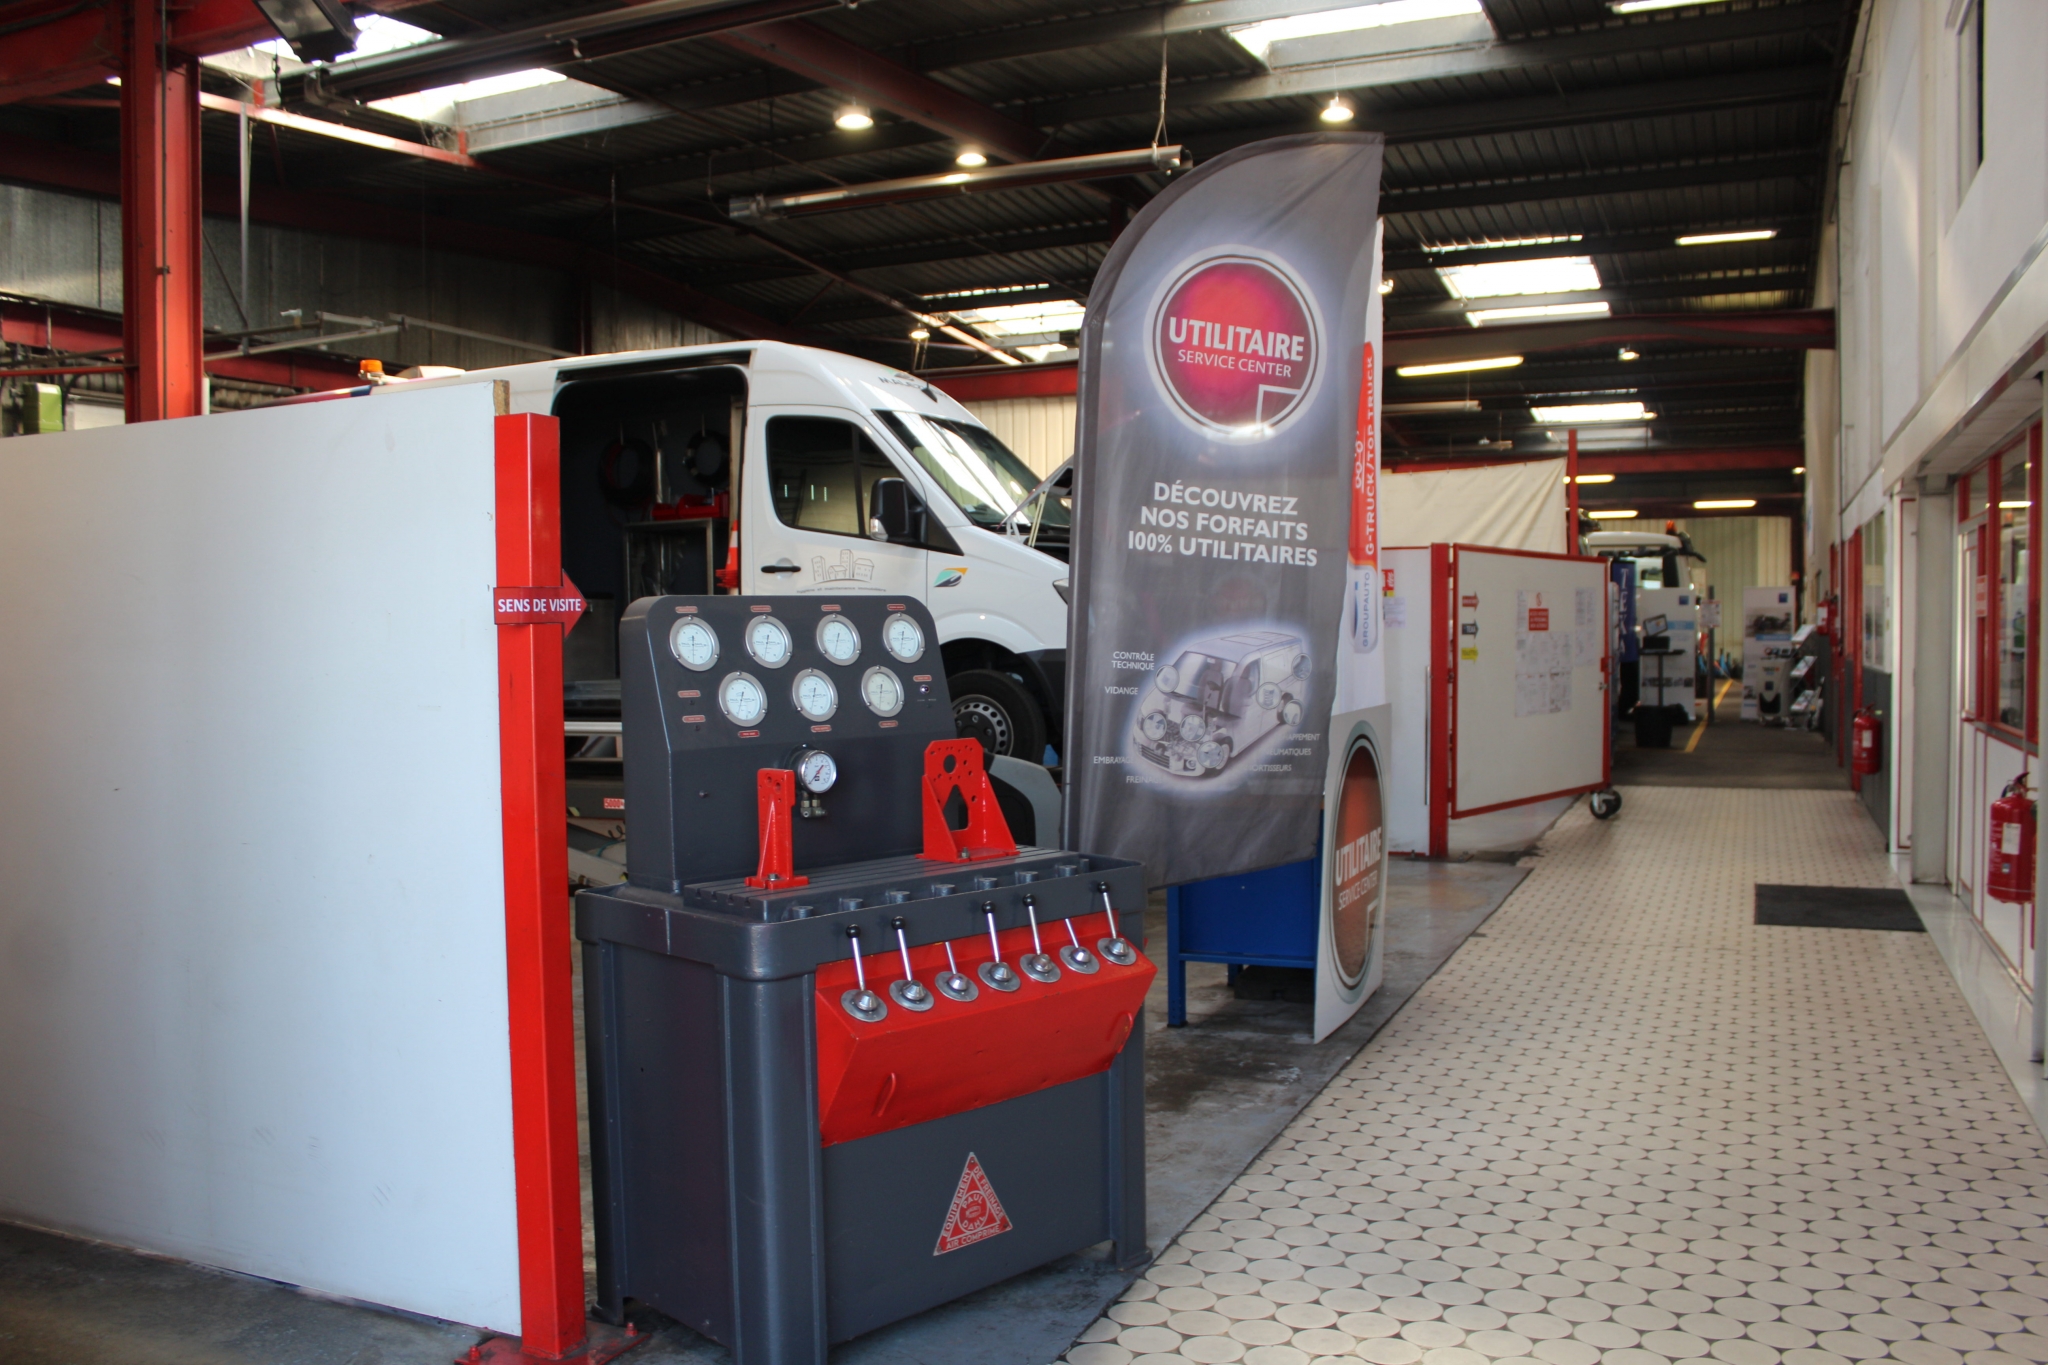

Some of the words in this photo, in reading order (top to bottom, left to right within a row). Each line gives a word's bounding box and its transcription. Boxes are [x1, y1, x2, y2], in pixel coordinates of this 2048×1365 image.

[1169, 316, 1305, 362] UTILITAIRE
[1177, 349, 1236, 370] SERVICE
[1238, 358, 1292, 378] CENTER
[1154, 479, 1299, 516] DÉCOUVREZ
[1365, 424, 1375, 555] G-TRUCK/TOP
[1140, 505, 1189, 530] NOS
[1196, 512, 1308, 541] FORFAITS
[1128, 530, 1173, 553] 100%
[1179, 536, 1318, 567] UTILITAIRES
[498, 598, 531, 613] SENS
[533, 598, 547, 612] DE
[549, 598, 582, 612] VISITE
[1362, 571, 1371, 647] GROUPAUTO
[1111, 660, 1155, 671] TECHNIQUE
[1113, 650, 1155, 662] CONTRÔLE
[1104, 686, 1139, 696] VIDANGE
[1335, 826, 1382, 887] UTILITAIRE
[1338, 880, 1361, 911] SERVICE
[942, 1166, 972, 1238] EQUIPEMENT
[961, 1193, 984, 1209] PAUL
[973, 1165, 983, 1180] DE
[979, 1180, 1005, 1220] FREINAGE
[945, 1239, 960, 1250] AIR
